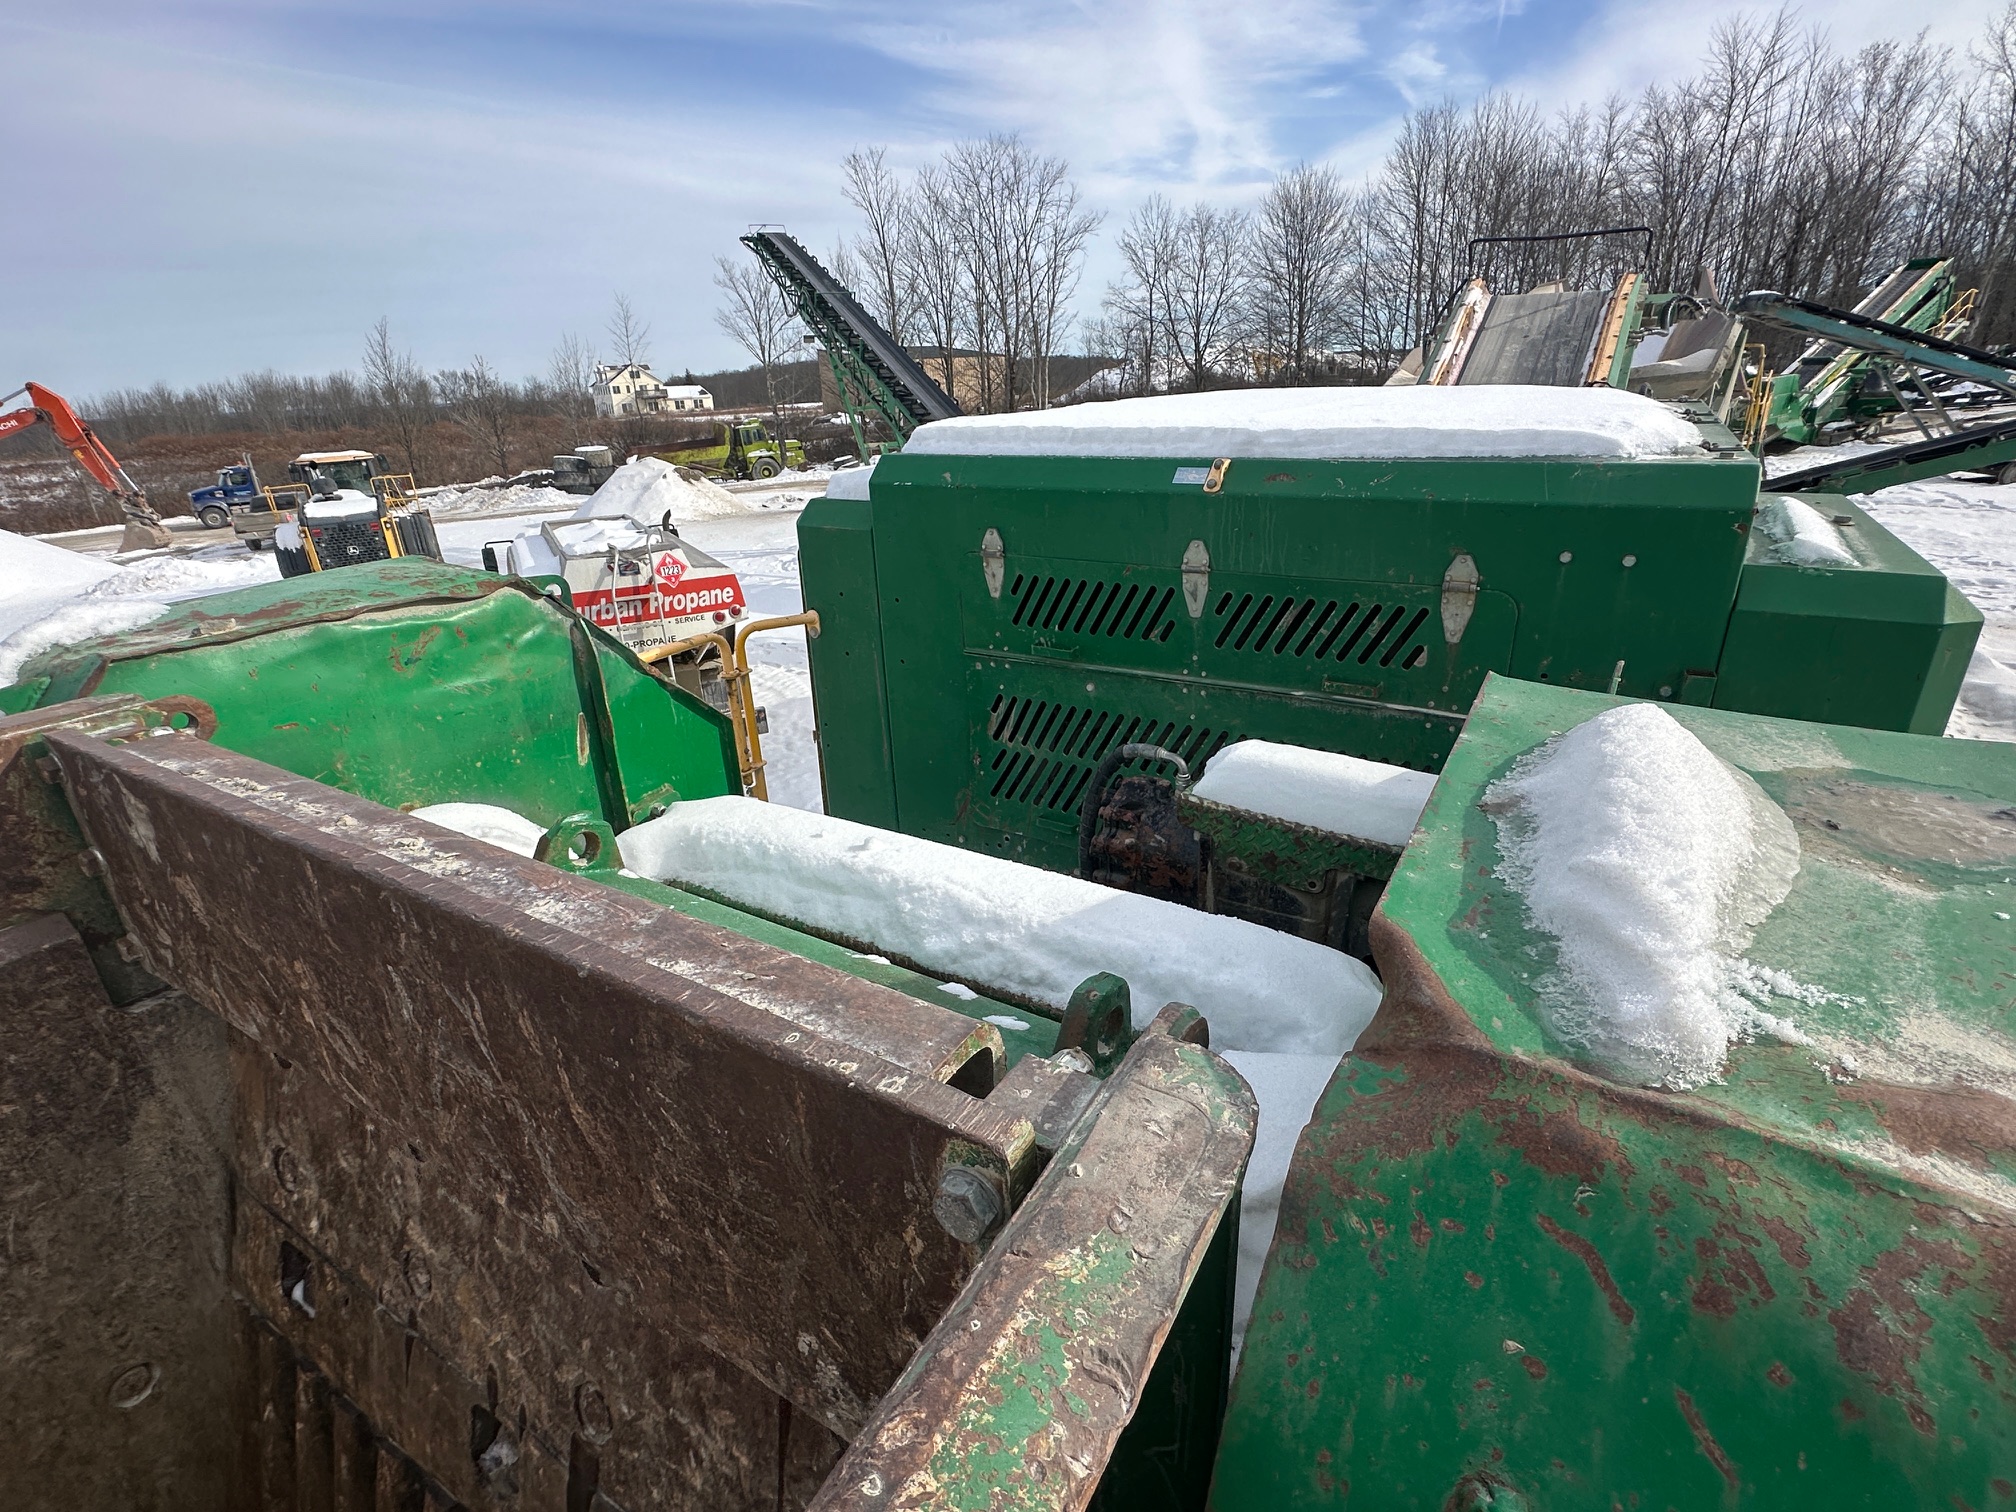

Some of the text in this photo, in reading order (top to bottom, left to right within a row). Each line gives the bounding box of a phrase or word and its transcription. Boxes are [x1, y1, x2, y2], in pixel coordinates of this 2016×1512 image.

[662, 565, 680, 576] 1223
[650, 586, 734, 613] Propane
[675, 614, 705, 624] SERVICE
